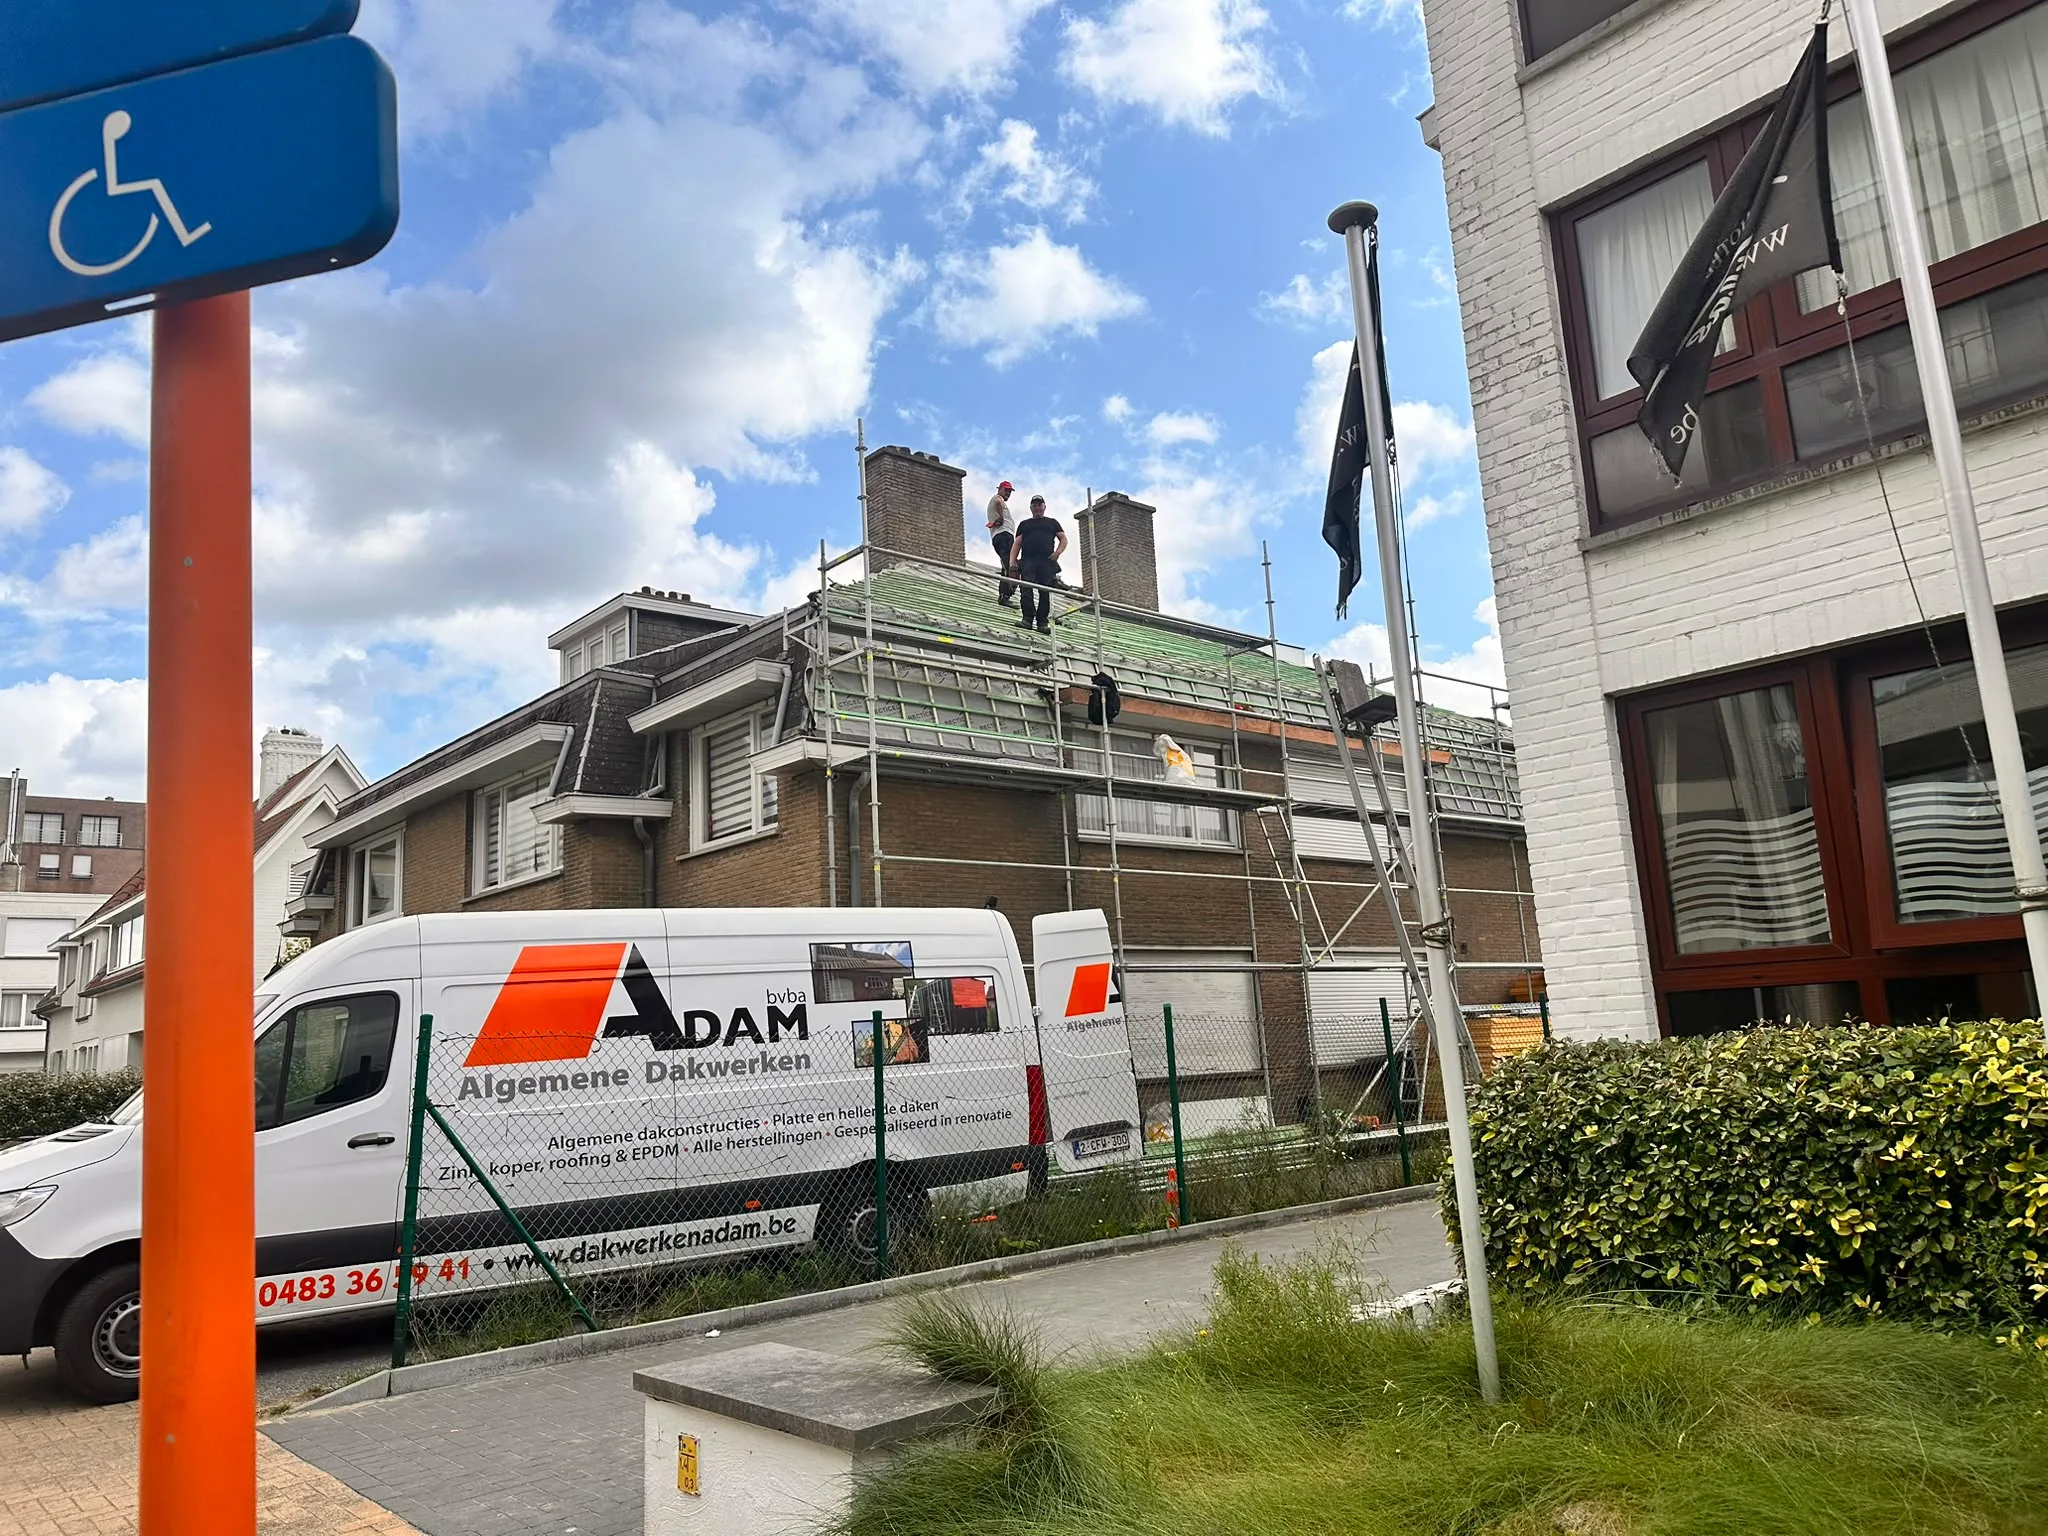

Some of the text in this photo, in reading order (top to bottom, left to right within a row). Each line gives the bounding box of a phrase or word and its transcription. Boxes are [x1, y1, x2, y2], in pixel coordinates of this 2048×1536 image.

[602, 943, 809, 1052] ADAM
[766, 988, 807, 1005] bvba
[1066, 1016, 1121, 1033] Algemene
[458, 1051, 812, 1104] Algemene Dakwerken
[489, 1160, 545, 1178] koper,
[549, 1152, 611, 1170] roofing
[615, 1149, 628, 1163] &
[632, 1144, 679, 1161] EPDM
[693, 1138, 723, 1154] Alle
[727, 1129, 822, 1150] herstellingen
[834, 1115, 937, 1139] Gespeialiseerd
[940, 1114, 952, 1127] in
[955, 1108, 1012, 1125] renovatie
[548, 1132, 633, 1152] Algemene
[638, 1117, 760, 1141] dakconstructies
[772, 1112, 814, 1127] Platte
[818, 1110, 835, 1122] en
[900, 1099, 939, 1114] daken
[258, 1273, 336, 1307] 0483
[345, 1268, 384, 1296] 36
[438, 1256, 469, 1282] 41
